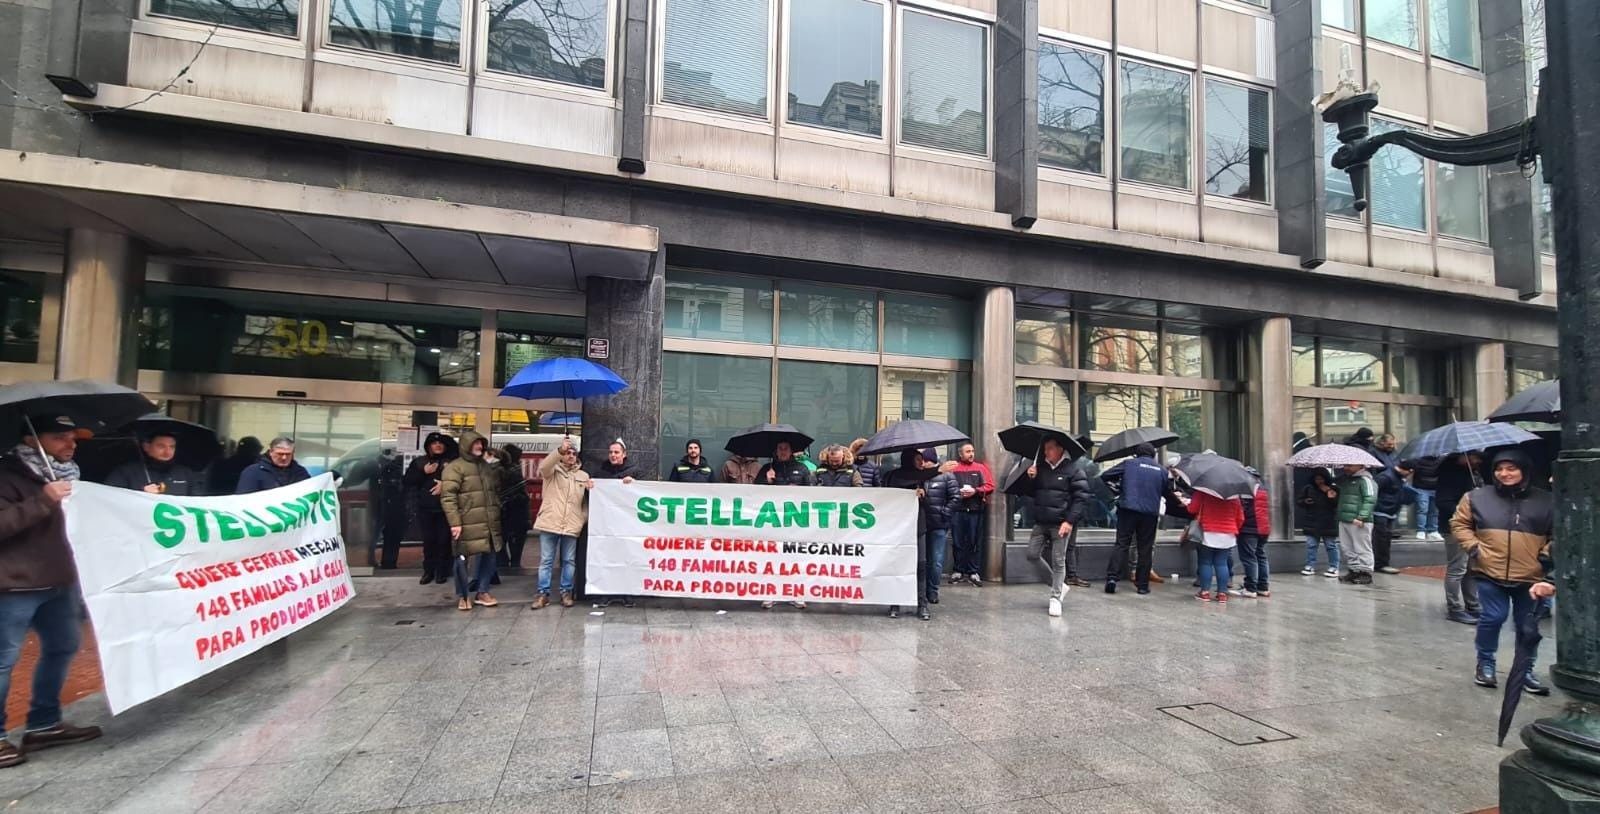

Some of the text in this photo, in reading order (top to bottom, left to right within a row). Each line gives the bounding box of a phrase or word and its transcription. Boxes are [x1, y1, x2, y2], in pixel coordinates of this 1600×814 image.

[271, 320, 328, 355] 50
[153, 490, 337, 548] STELLANTIS
[637, 497, 876, 529] STELLANTIS
[175, 536, 340, 590] QUIERE CERRAR MECAN
[643, 538, 865, 557] QUIERE CERRAR MECANER
[648, 558, 862, 579] 148 FAMILIAS A LA CALLE
[196, 595, 231, 621] 148
[230, 575, 298, 611] FAMILIAS
[299, 573, 310, 589] A
[310, 566, 323, 584] LA
[643, 579, 864, 599] PARA PRODUCIR EN CHINA
[196, 626, 246, 661] PARA
[250, 597, 316, 639] PRODUCIR
[317, 589, 331, 610] EN
